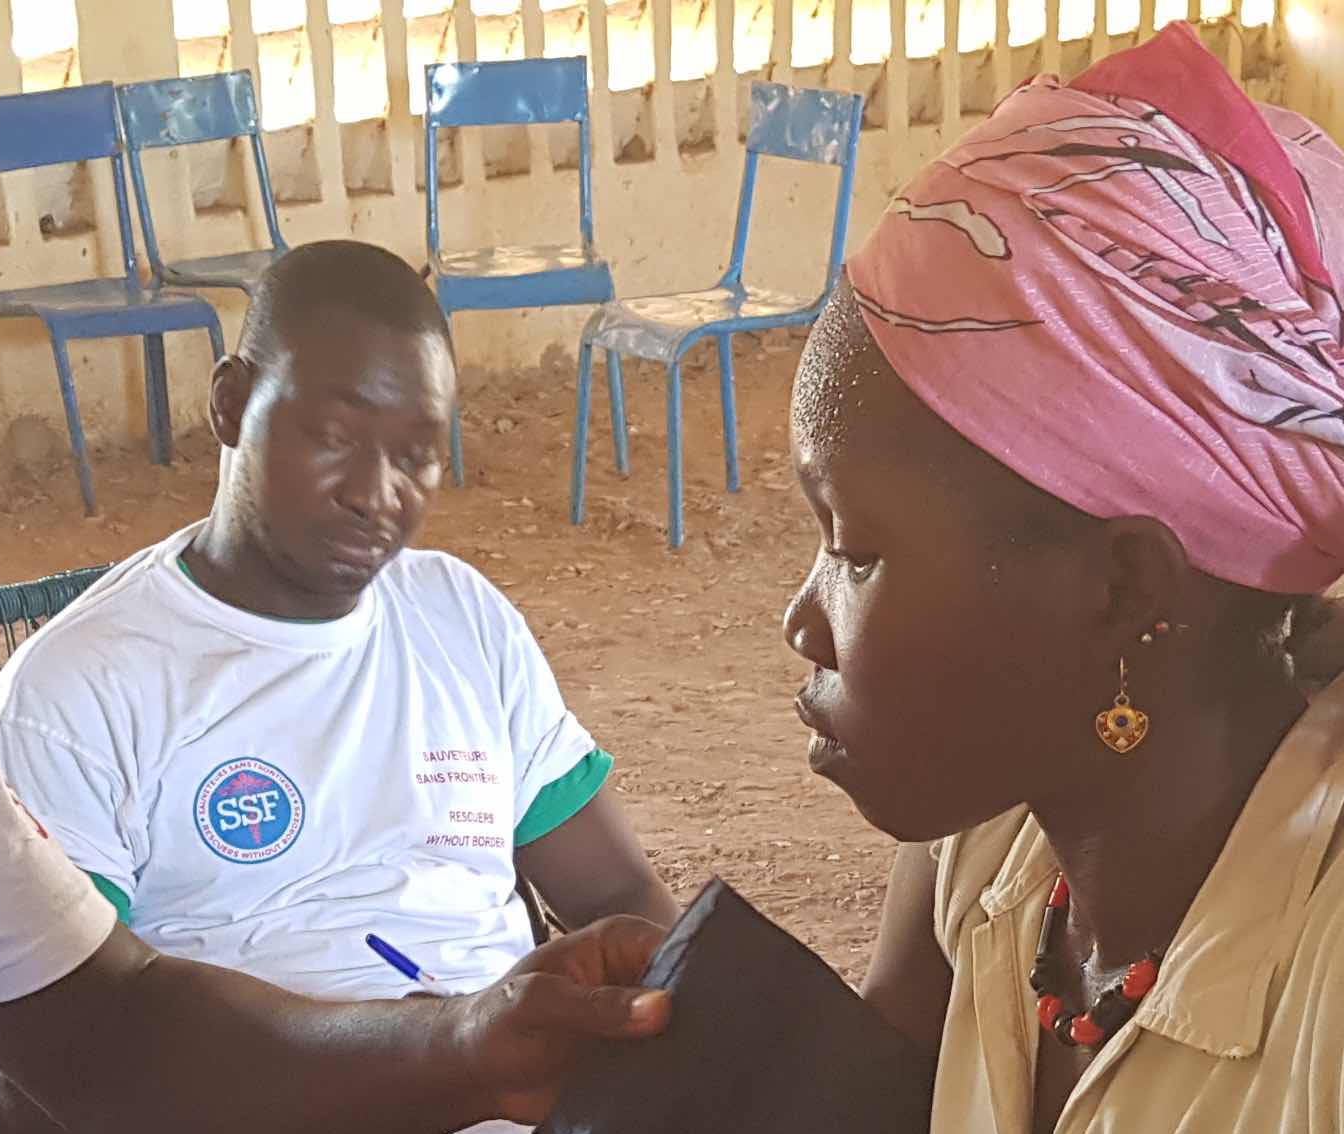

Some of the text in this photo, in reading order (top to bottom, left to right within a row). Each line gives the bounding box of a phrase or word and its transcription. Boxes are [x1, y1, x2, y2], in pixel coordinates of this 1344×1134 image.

[416, 773, 446, 785] SANS
[216, 790, 280, 832] SSF
[449, 811, 494, 825] RESCUERS
[426, 835, 471, 847] WITHOUT
